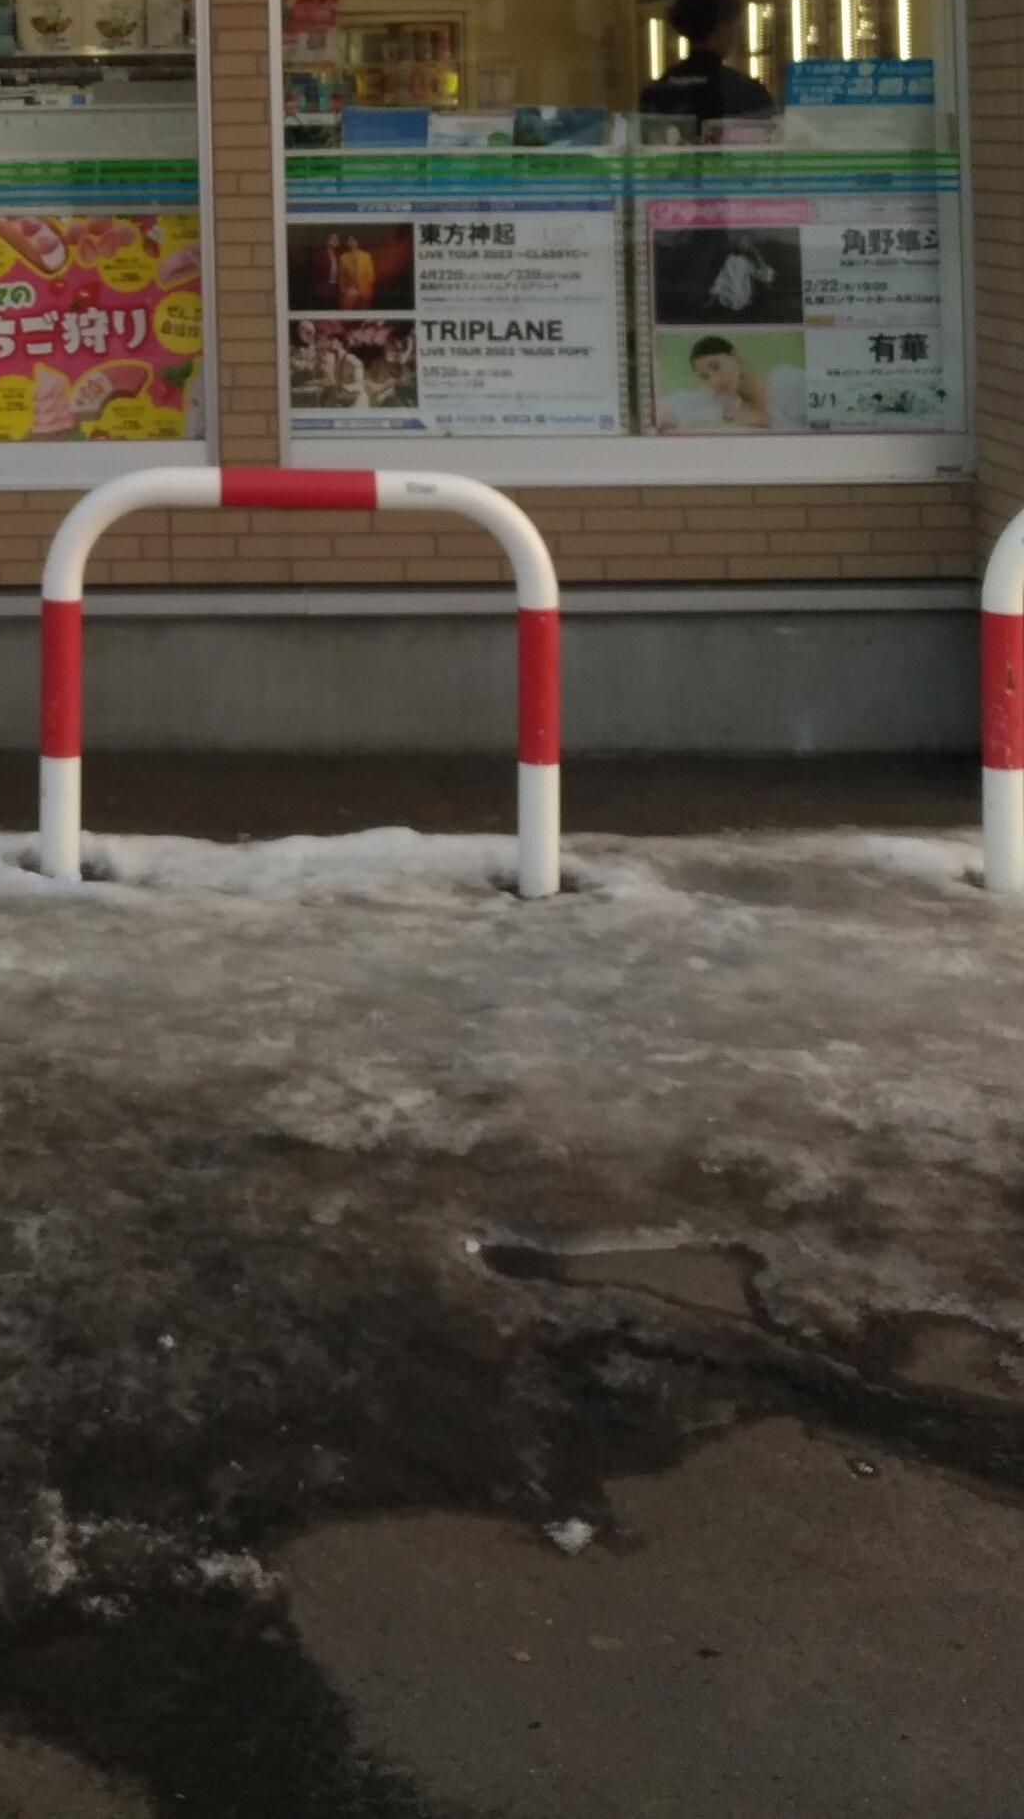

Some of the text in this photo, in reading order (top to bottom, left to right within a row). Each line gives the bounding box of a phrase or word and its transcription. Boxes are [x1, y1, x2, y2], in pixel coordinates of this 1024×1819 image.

[419, 222, 516, 246] 東方神起
[420, 320, 563, 342] TRIPLANE
